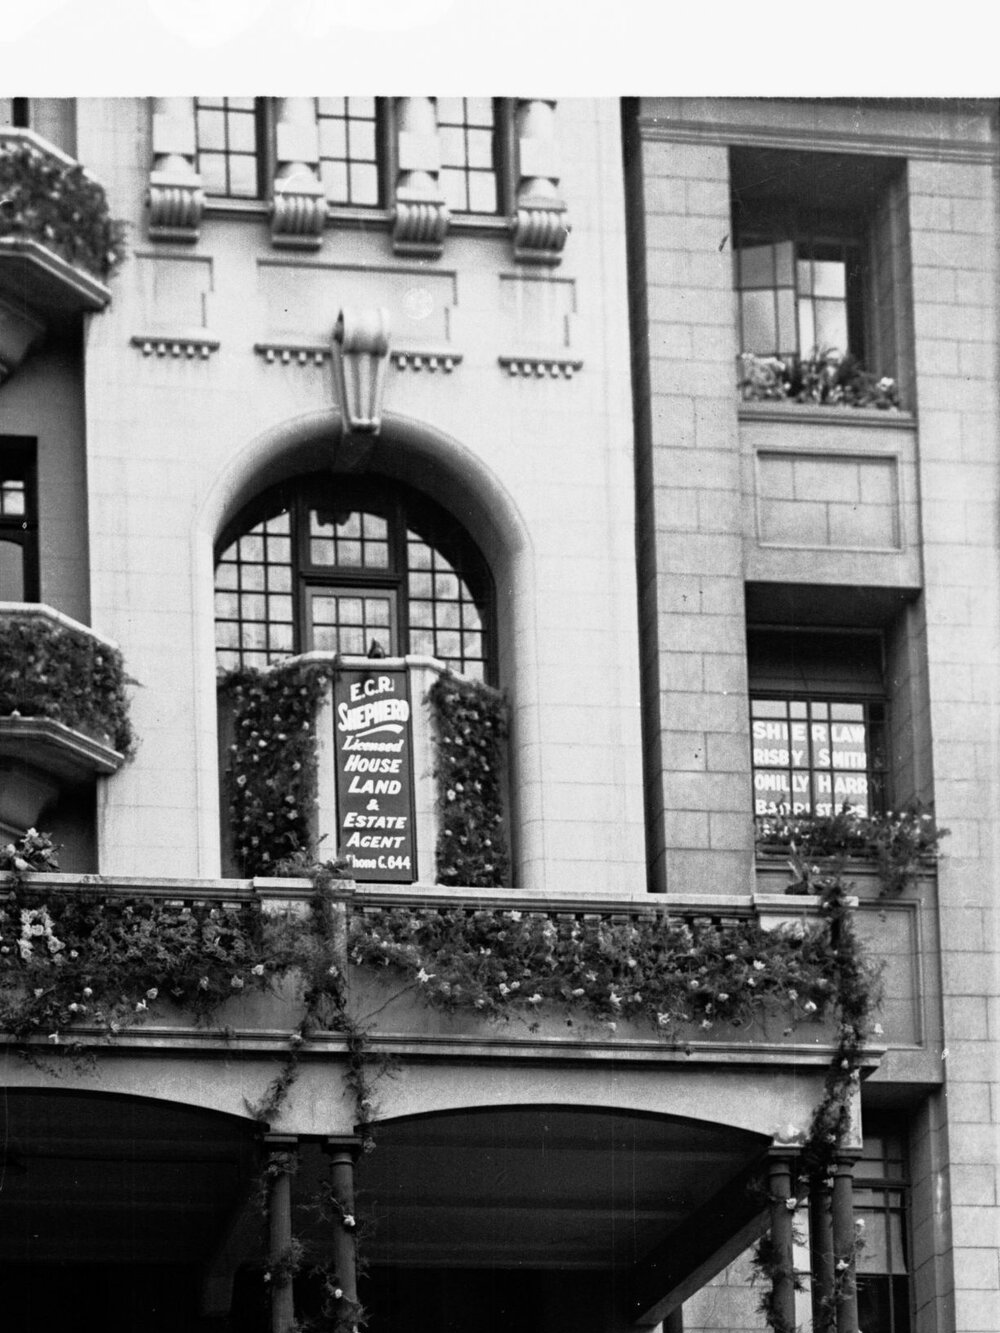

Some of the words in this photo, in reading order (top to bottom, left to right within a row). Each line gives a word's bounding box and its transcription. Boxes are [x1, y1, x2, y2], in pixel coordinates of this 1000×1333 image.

[337, 699, 410, 732] SHEPHERD
[341, 735, 405, 752] Licensed
[343, 755, 402, 774] HOUSE
[818, 748, 868, 769] SMITH
[348, 775, 402, 794] LAND
[366, 798, 380, 811] &
[343, 812, 407, 829] ESTATE
[346, 831, 406, 849] AGENT
